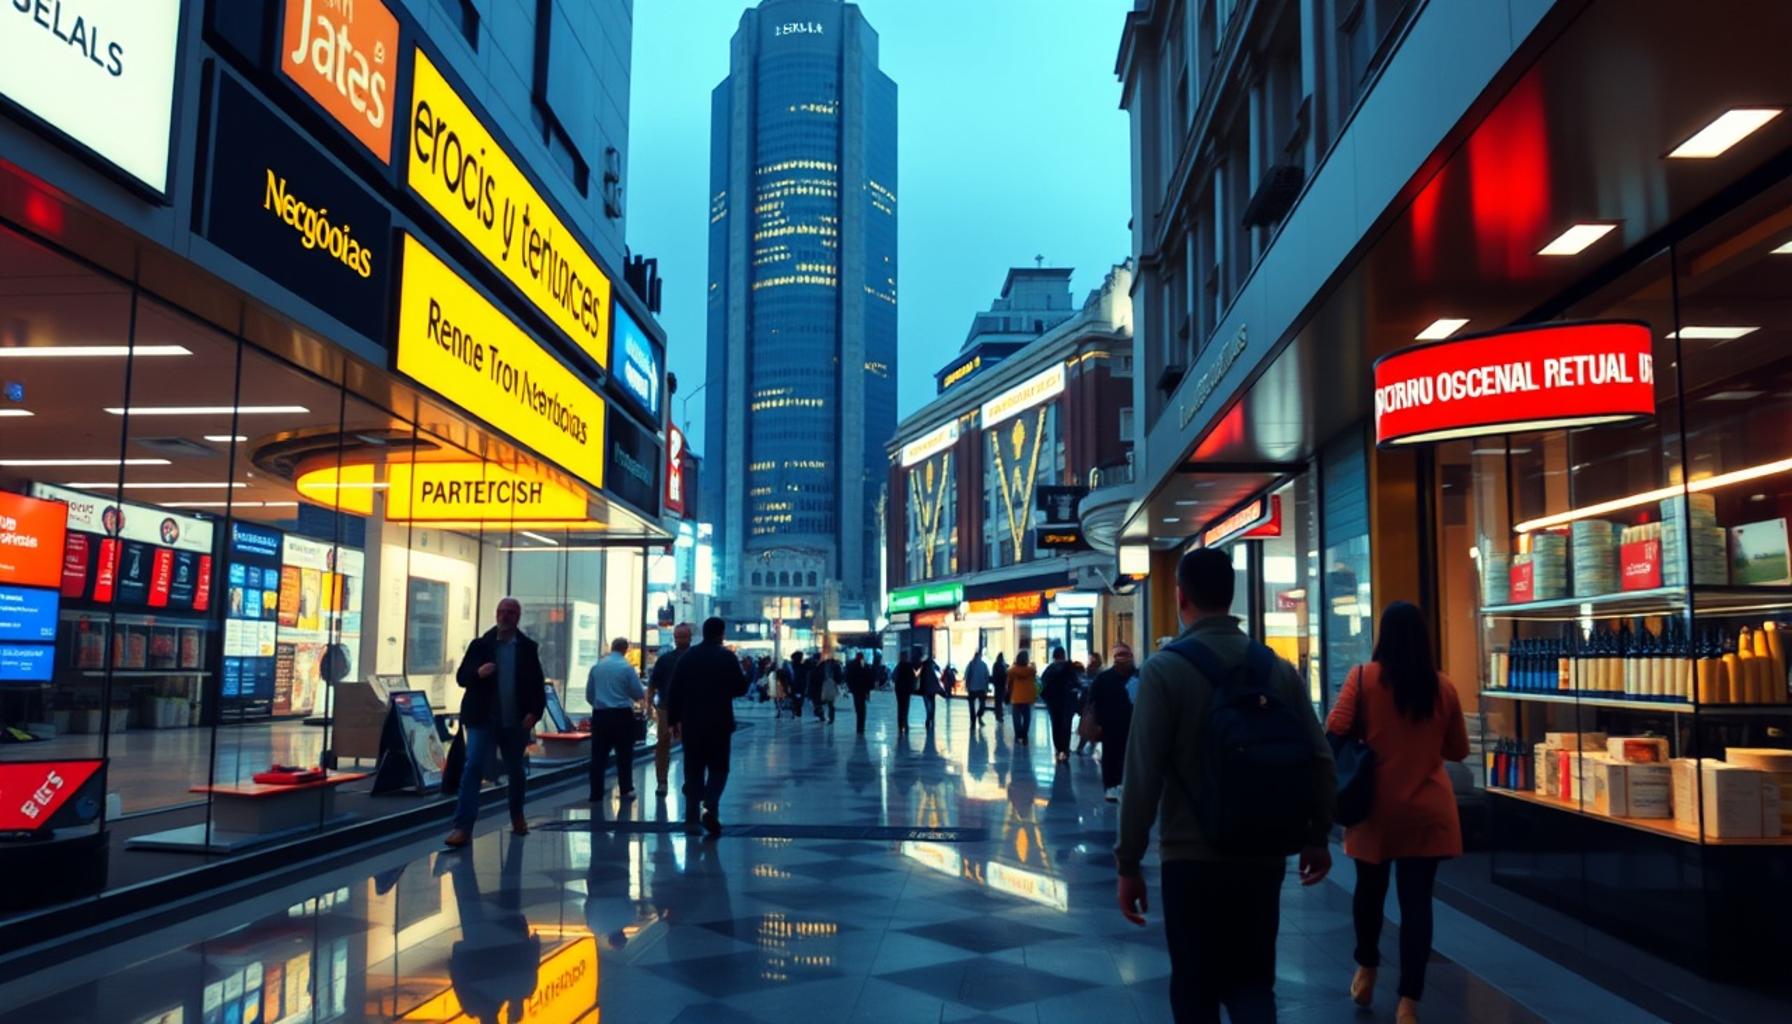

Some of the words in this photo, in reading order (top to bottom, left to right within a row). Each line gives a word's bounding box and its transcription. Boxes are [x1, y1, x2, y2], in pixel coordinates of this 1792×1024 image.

[12, 0, 123, 77] ELALS
[501, 197, 516, 262] y
[1437, 360, 1541, 402] OSCENAL
[1544, 352, 1633, 388] RETUAL
